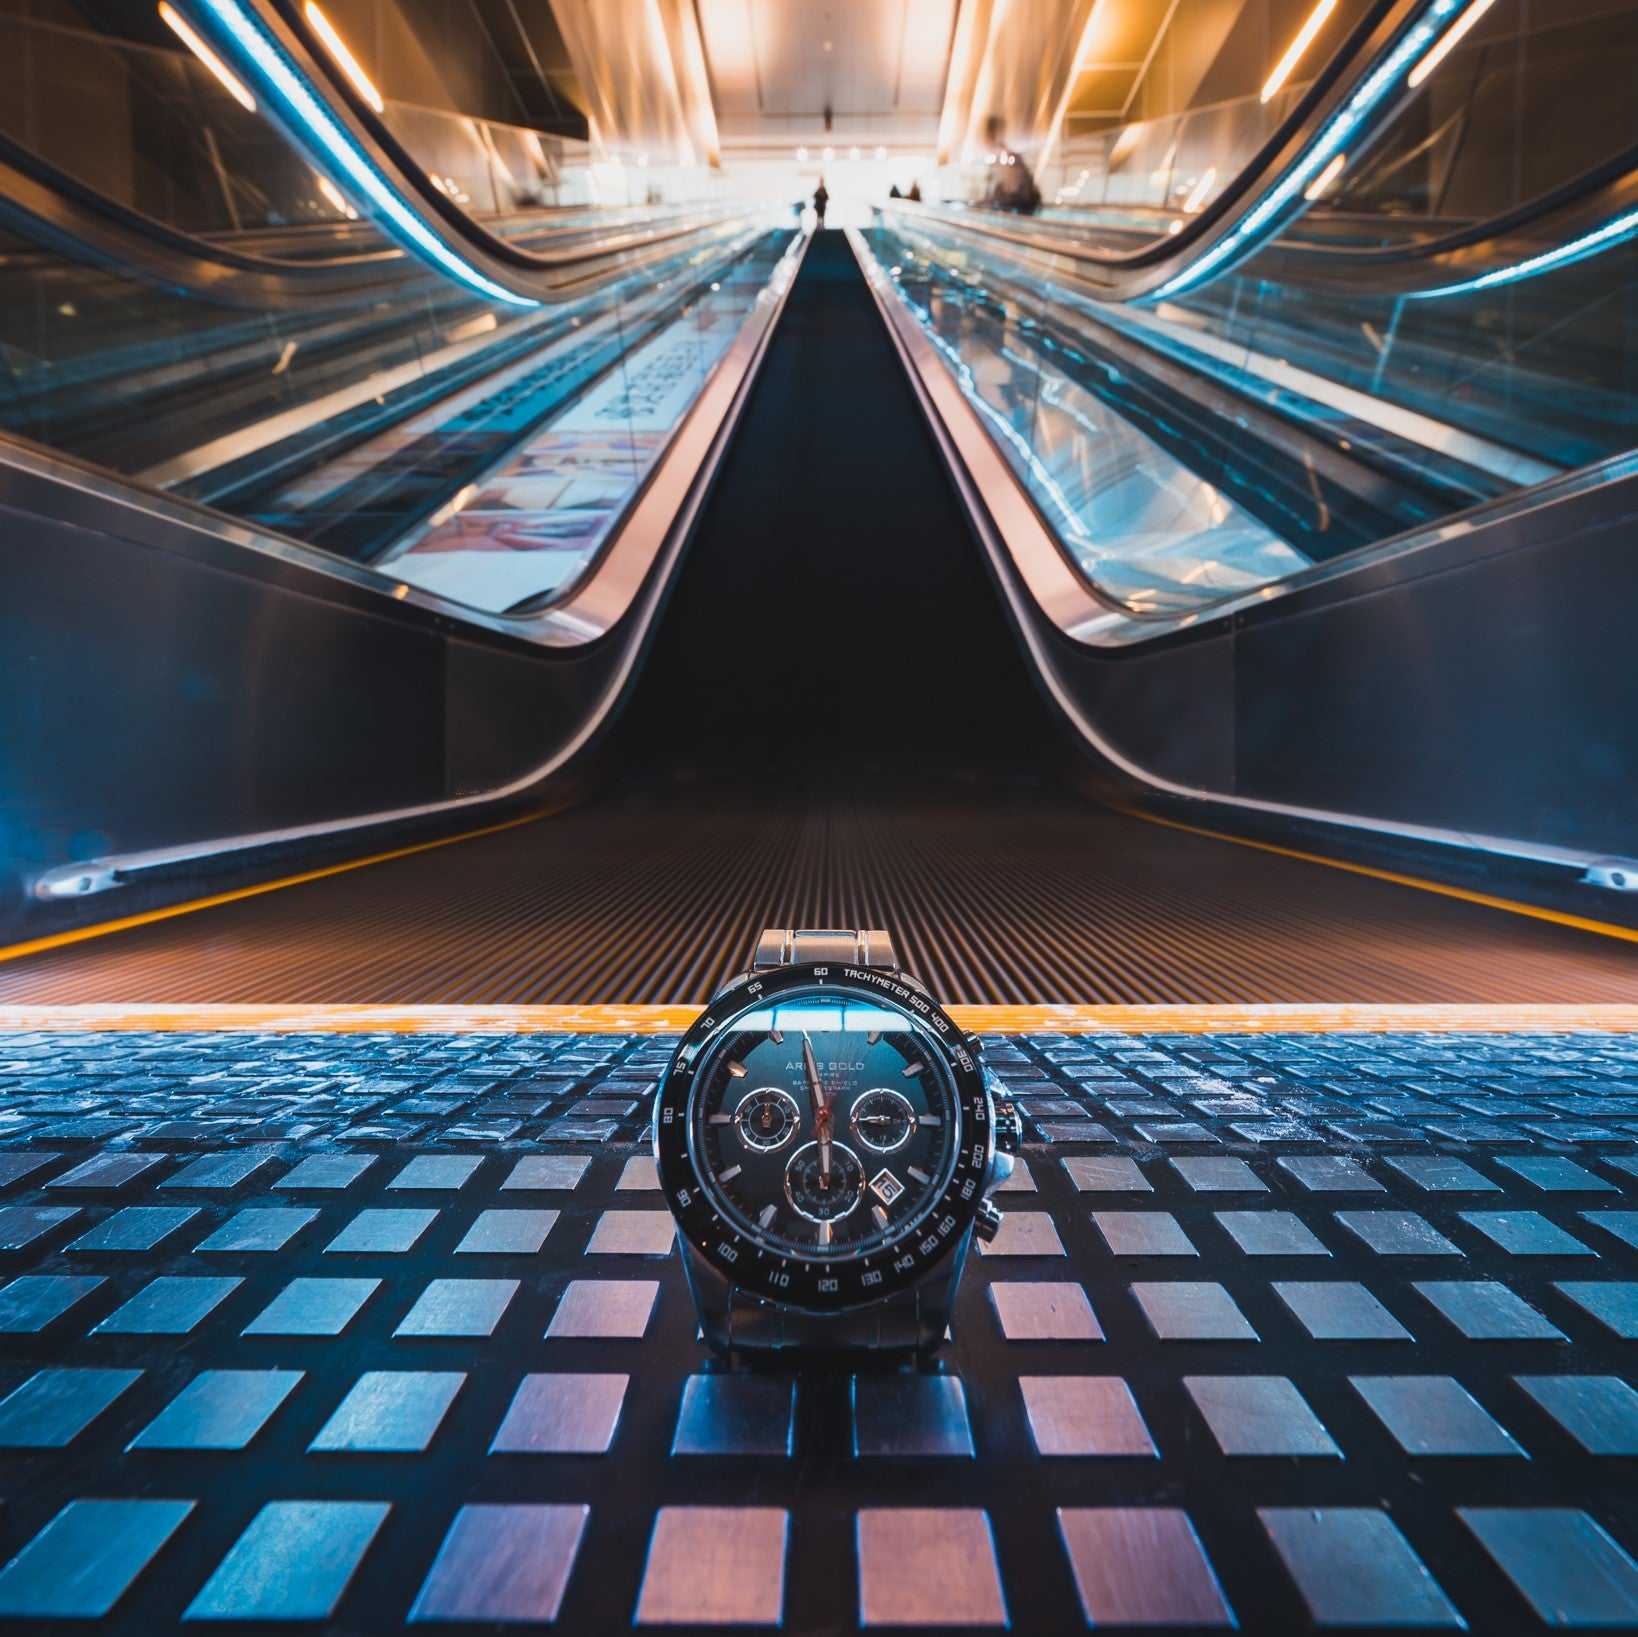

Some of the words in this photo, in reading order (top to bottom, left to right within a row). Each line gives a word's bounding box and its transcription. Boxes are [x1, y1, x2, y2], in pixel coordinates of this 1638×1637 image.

[813, 967, 828, 976] 60
[747, 981, 763, 995] 65
[844, 968, 910, 999] TACHYMETER
[908, 994, 930, 1014] 500
[931, 1012, 949, 1033] 400
[700, 1017, 715, 1029] 70
[672, 1061, 686, 1076] 75
[785, 1062, 824, 1071] ARIS
[828, 1062, 865, 1071] GOLD
[957, 1050, 974, 1072] 300
[663, 1107, 673, 1124] 80
[973, 1096, 985, 1121] 240
[972, 1144, 984, 1169] 200
[873, 1177, 896, 1199] 15
[960, 1178, 976, 1200] 180
[676, 1189, 691, 1207] 90
[937, 1216, 956, 1237] 160
[717, 1242, 739, 1263] 100
[920, 1235, 939, 1255] 150
[894, 1254, 915, 1272] 140
[768, 1271, 790, 1287] 110
[817, 1278, 839, 1293] 120
[861, 1270, 883, 1287] 130
